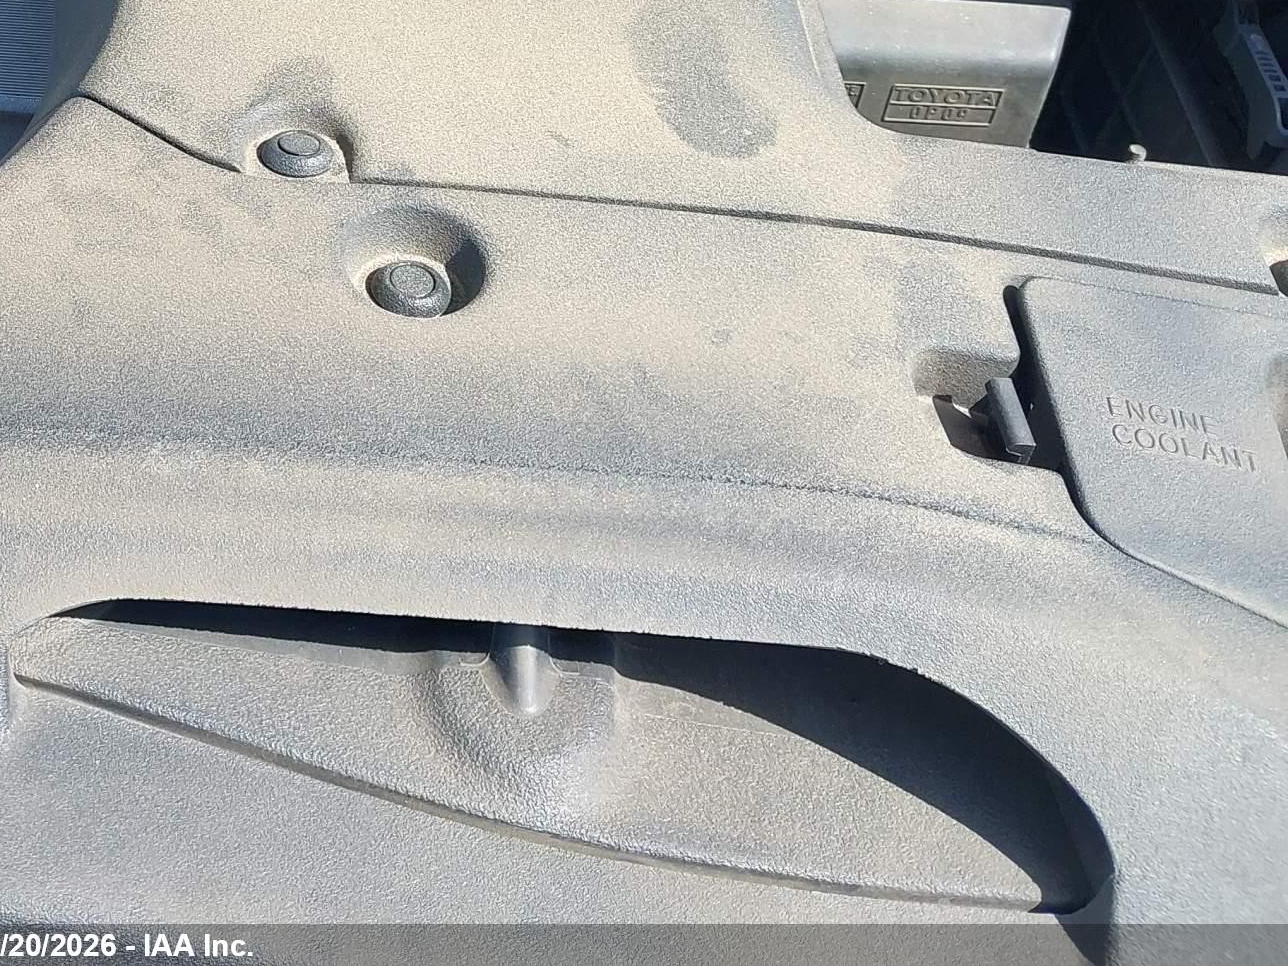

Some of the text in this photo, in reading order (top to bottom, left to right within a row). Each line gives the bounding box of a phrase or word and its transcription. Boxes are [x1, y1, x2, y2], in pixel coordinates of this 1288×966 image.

[894, 86, 997, 107] TOYOTA
[1106, 396, 1216, 435] ENGINE
[1112, 423, 1257, 472] COOLANT
